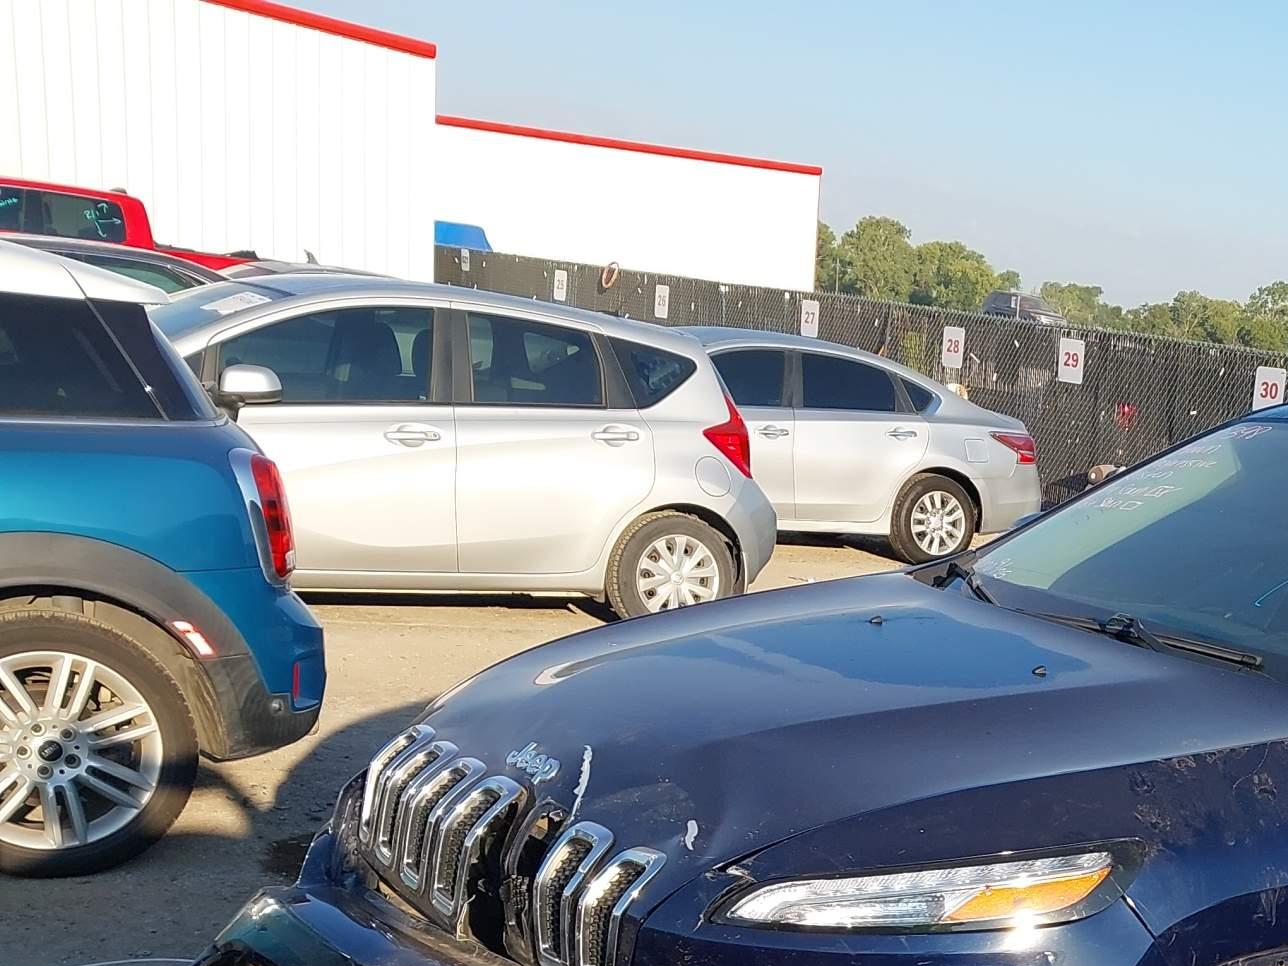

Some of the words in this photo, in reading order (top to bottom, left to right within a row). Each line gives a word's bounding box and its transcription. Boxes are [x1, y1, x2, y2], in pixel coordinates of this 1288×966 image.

[804, 310, 816, 325] 27
[946, 338, 960, 354] 28
[1063, 351, 1079, 369] 29
[1259, 381, 1279, 400] 30
[505, 741, 561, 785] Jeep
